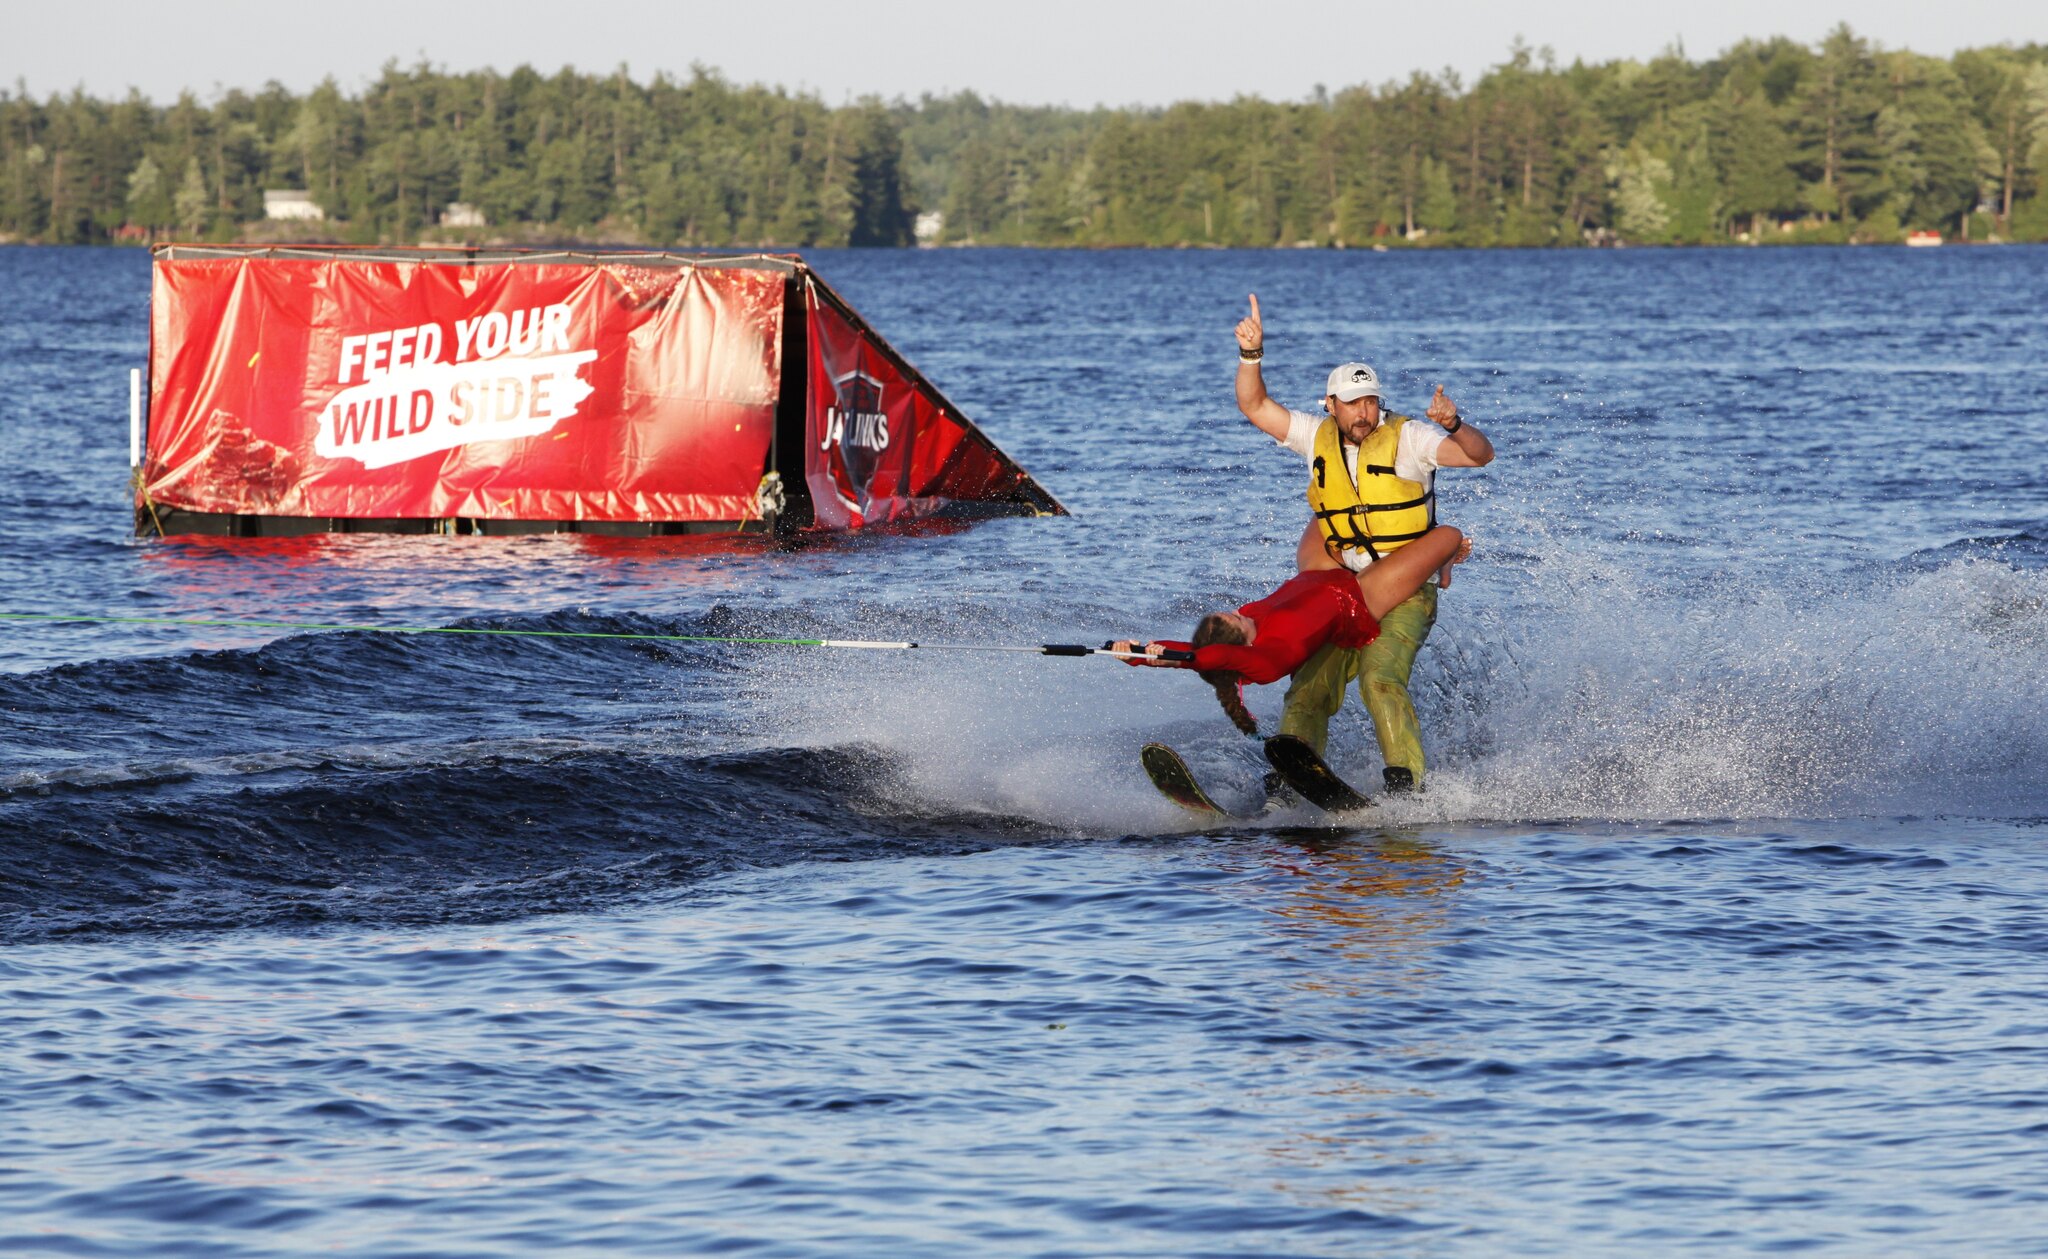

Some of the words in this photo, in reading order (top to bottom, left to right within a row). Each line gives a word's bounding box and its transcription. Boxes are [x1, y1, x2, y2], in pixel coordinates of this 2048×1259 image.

[338, 322, 443, 384] FEED
[454, 302, 572, 362] YOUR
[332, 388, 435, 447] WILD
[448, 372, 555, 427] SIDE
